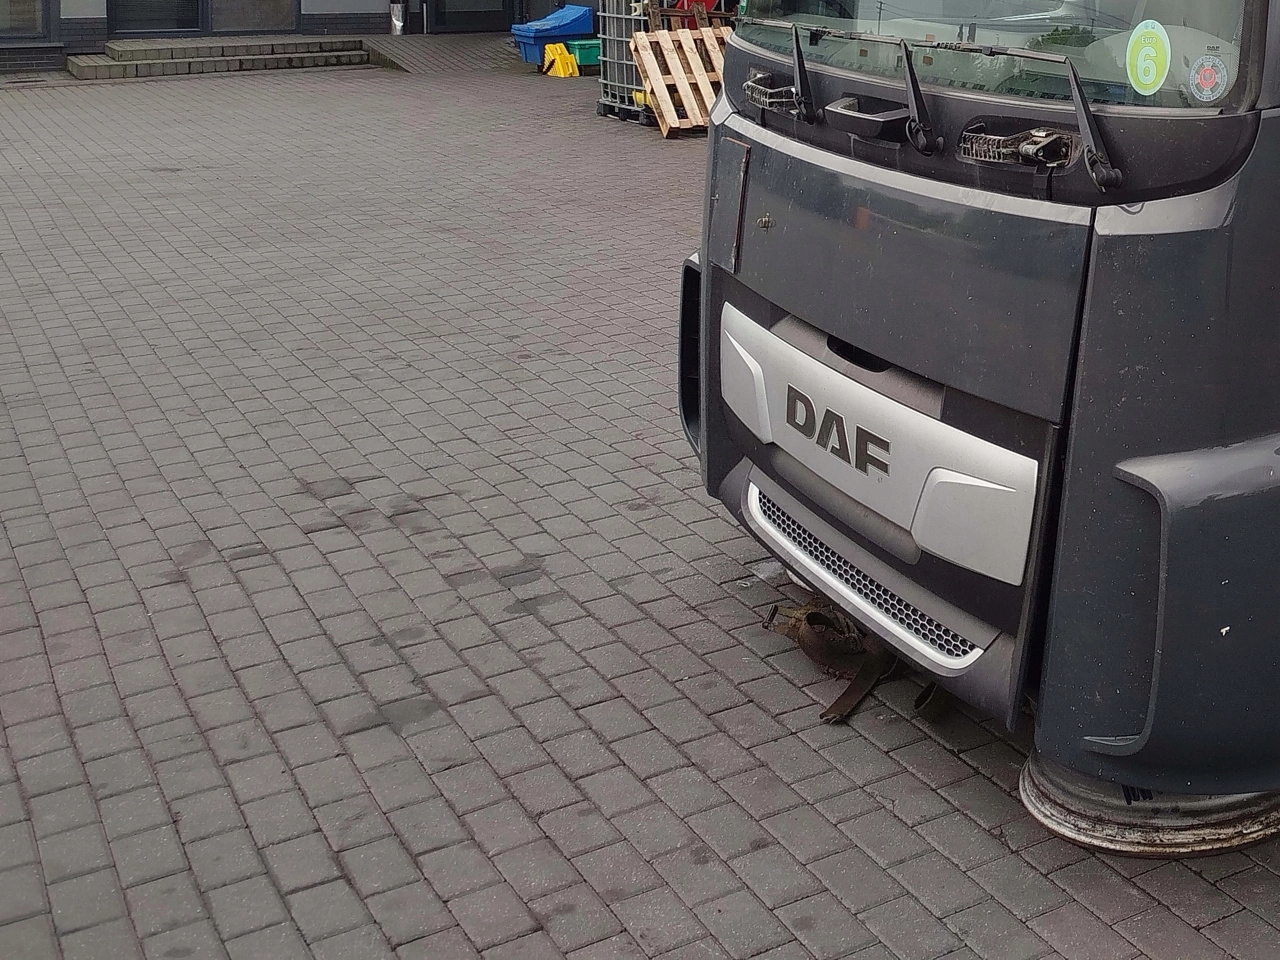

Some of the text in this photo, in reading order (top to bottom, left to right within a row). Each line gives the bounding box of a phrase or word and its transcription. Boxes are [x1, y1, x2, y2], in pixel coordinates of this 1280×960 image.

[1141, 35, 1157, 44] Euro
[1137, 46, 1157, 85] 6
[785, 382, 893, 478] DAF
